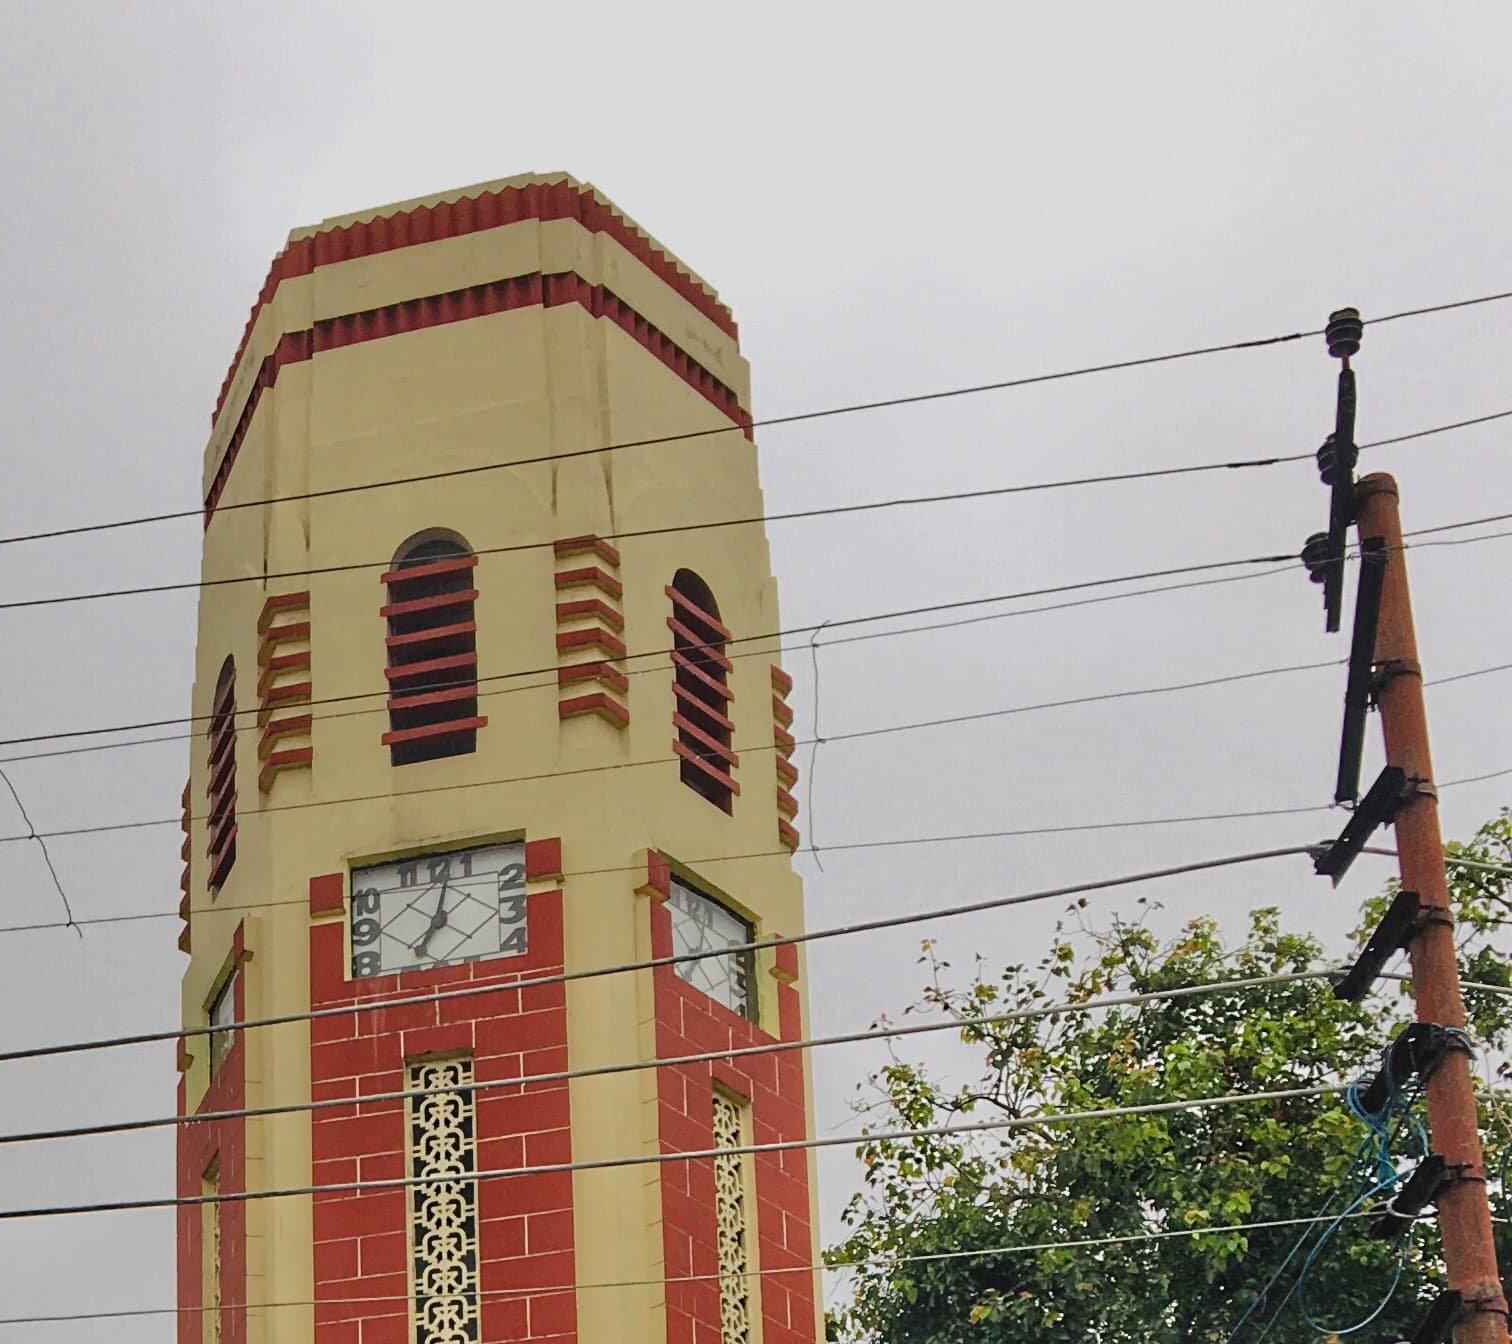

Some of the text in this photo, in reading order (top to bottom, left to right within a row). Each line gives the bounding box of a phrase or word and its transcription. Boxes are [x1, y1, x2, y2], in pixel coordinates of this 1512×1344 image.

[498, 862, 526, 891] 2
[354, 887, 381, 917] 10
[499, 894, 527, 925] 3
[352, 918, 382, 946] 9
[499, 926, 526, 954] 4
[352, 950, 382, 979] 8
